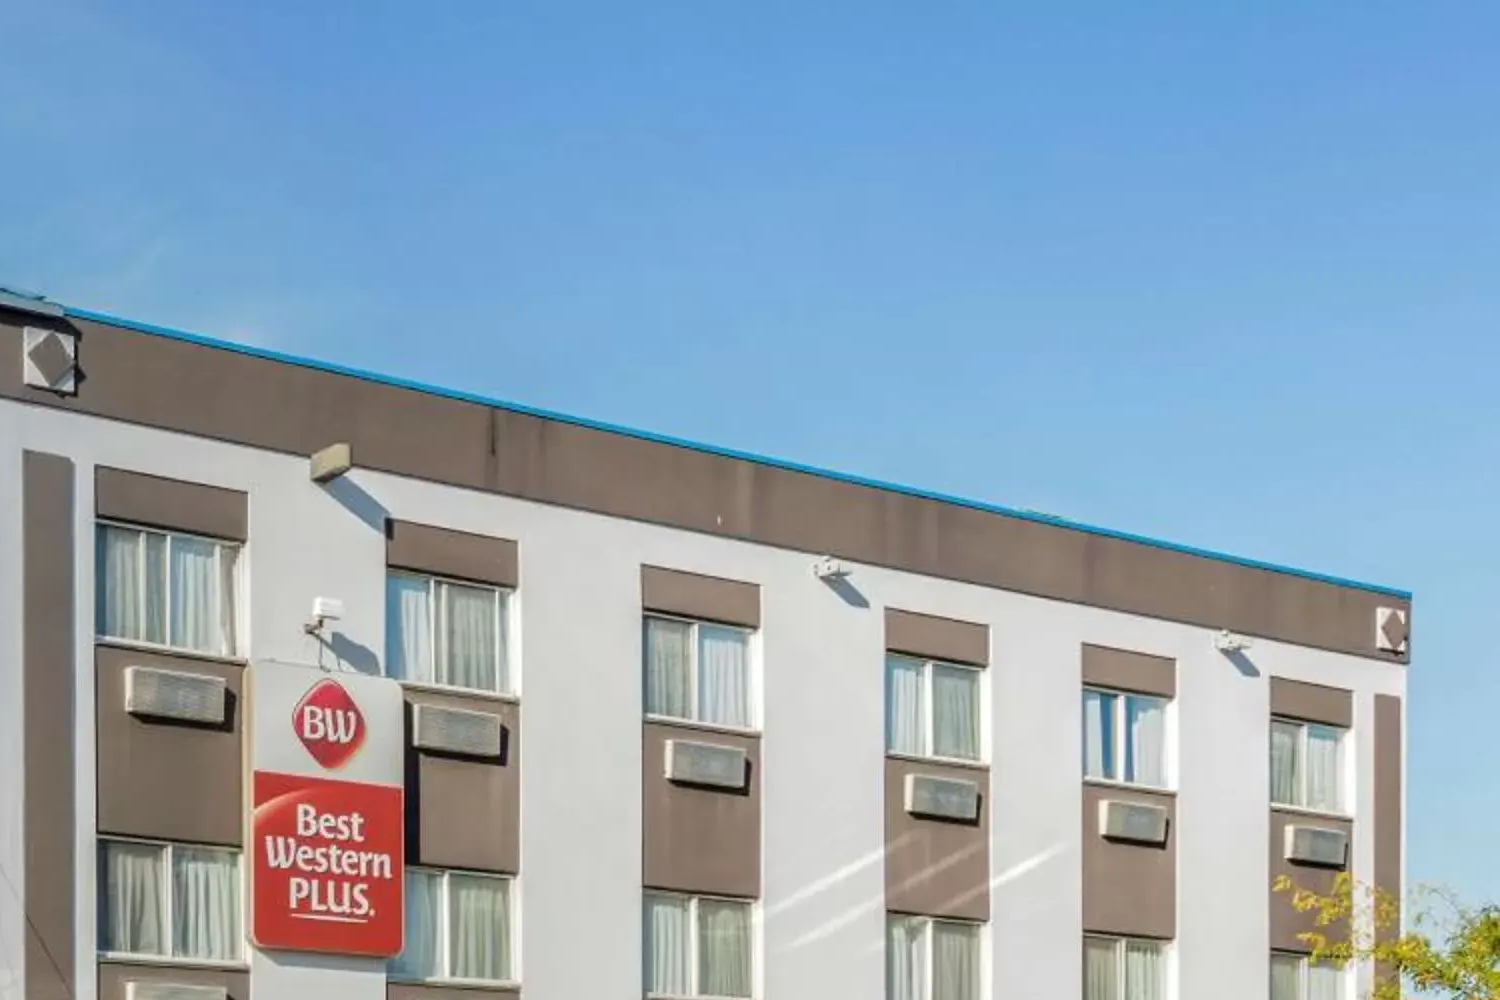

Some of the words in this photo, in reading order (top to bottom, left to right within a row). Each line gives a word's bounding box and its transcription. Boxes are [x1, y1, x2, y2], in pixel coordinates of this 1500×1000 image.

[303, 705, 357, 744] BW
[297, 804, 365, 842] Best
[265, 836, 393, 879] Western
